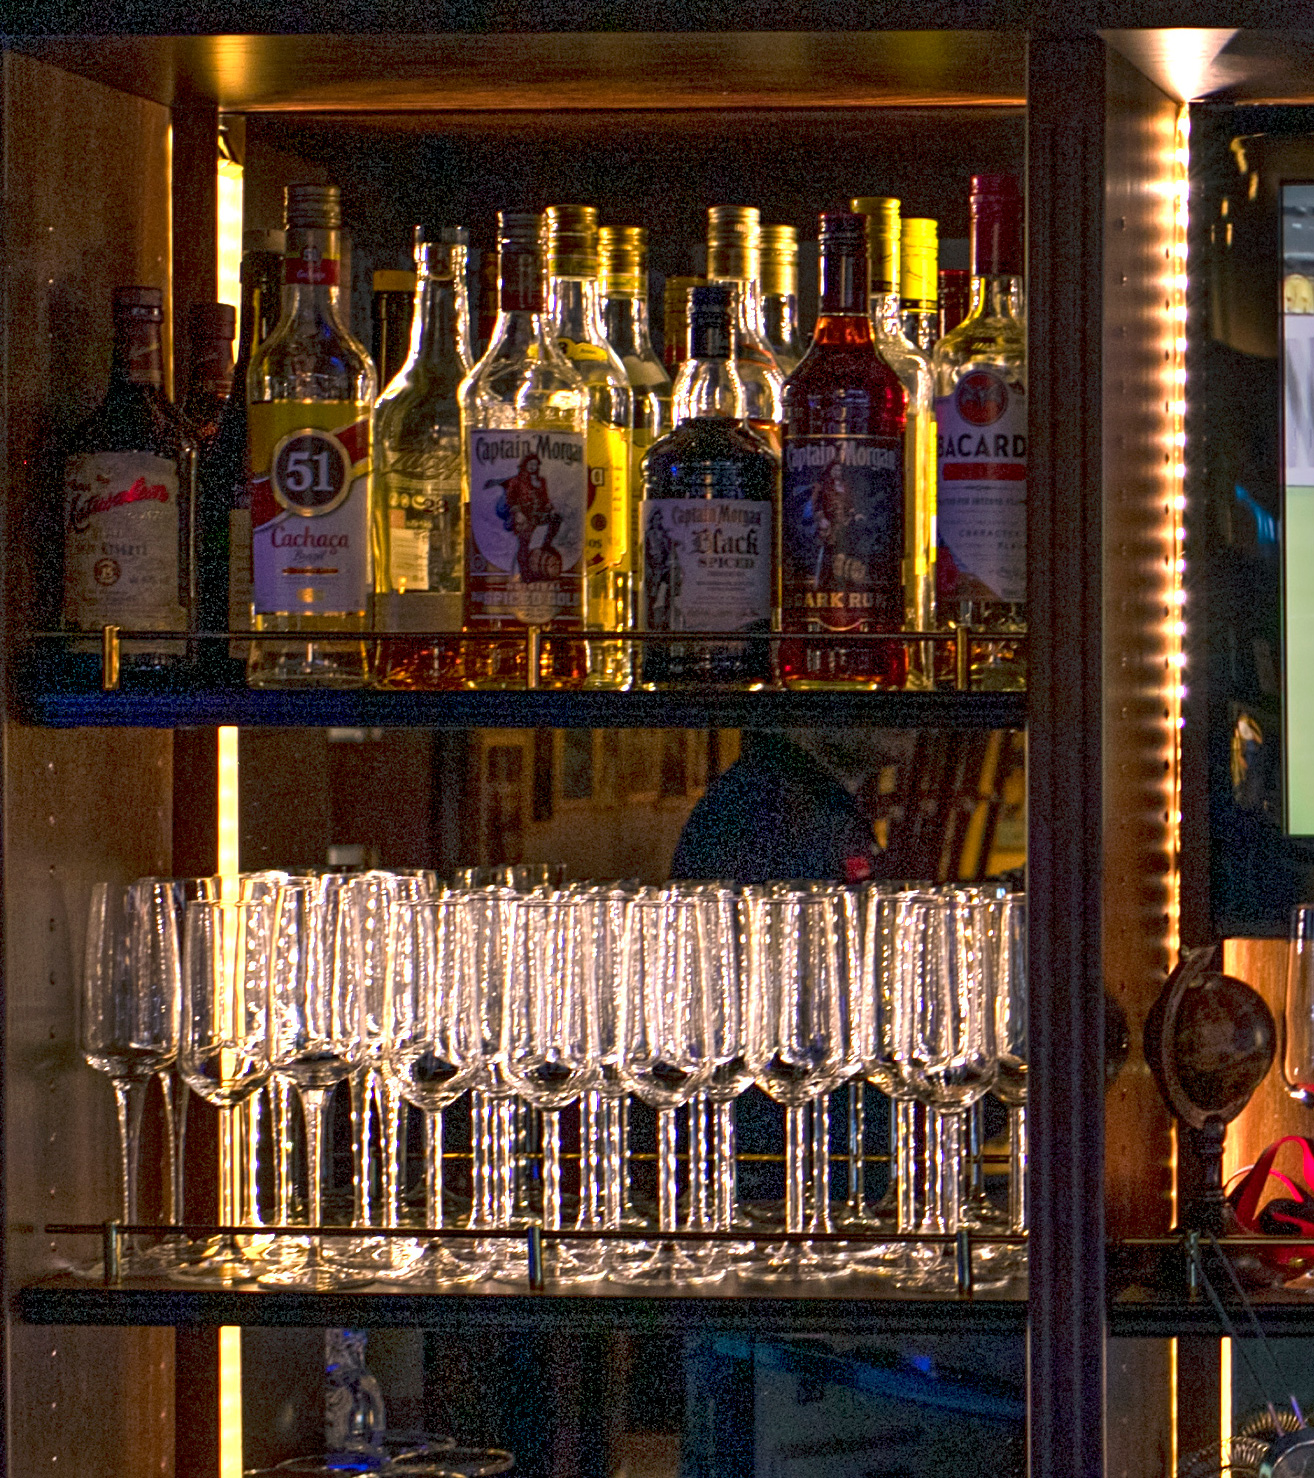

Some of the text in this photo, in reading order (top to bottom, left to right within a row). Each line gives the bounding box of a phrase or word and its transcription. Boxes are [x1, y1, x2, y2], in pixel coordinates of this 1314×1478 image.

[475, 435, 531, 466] Captain
[286, 451, 335, 492] 51
[271, 526, 349, 555] Cachaça
